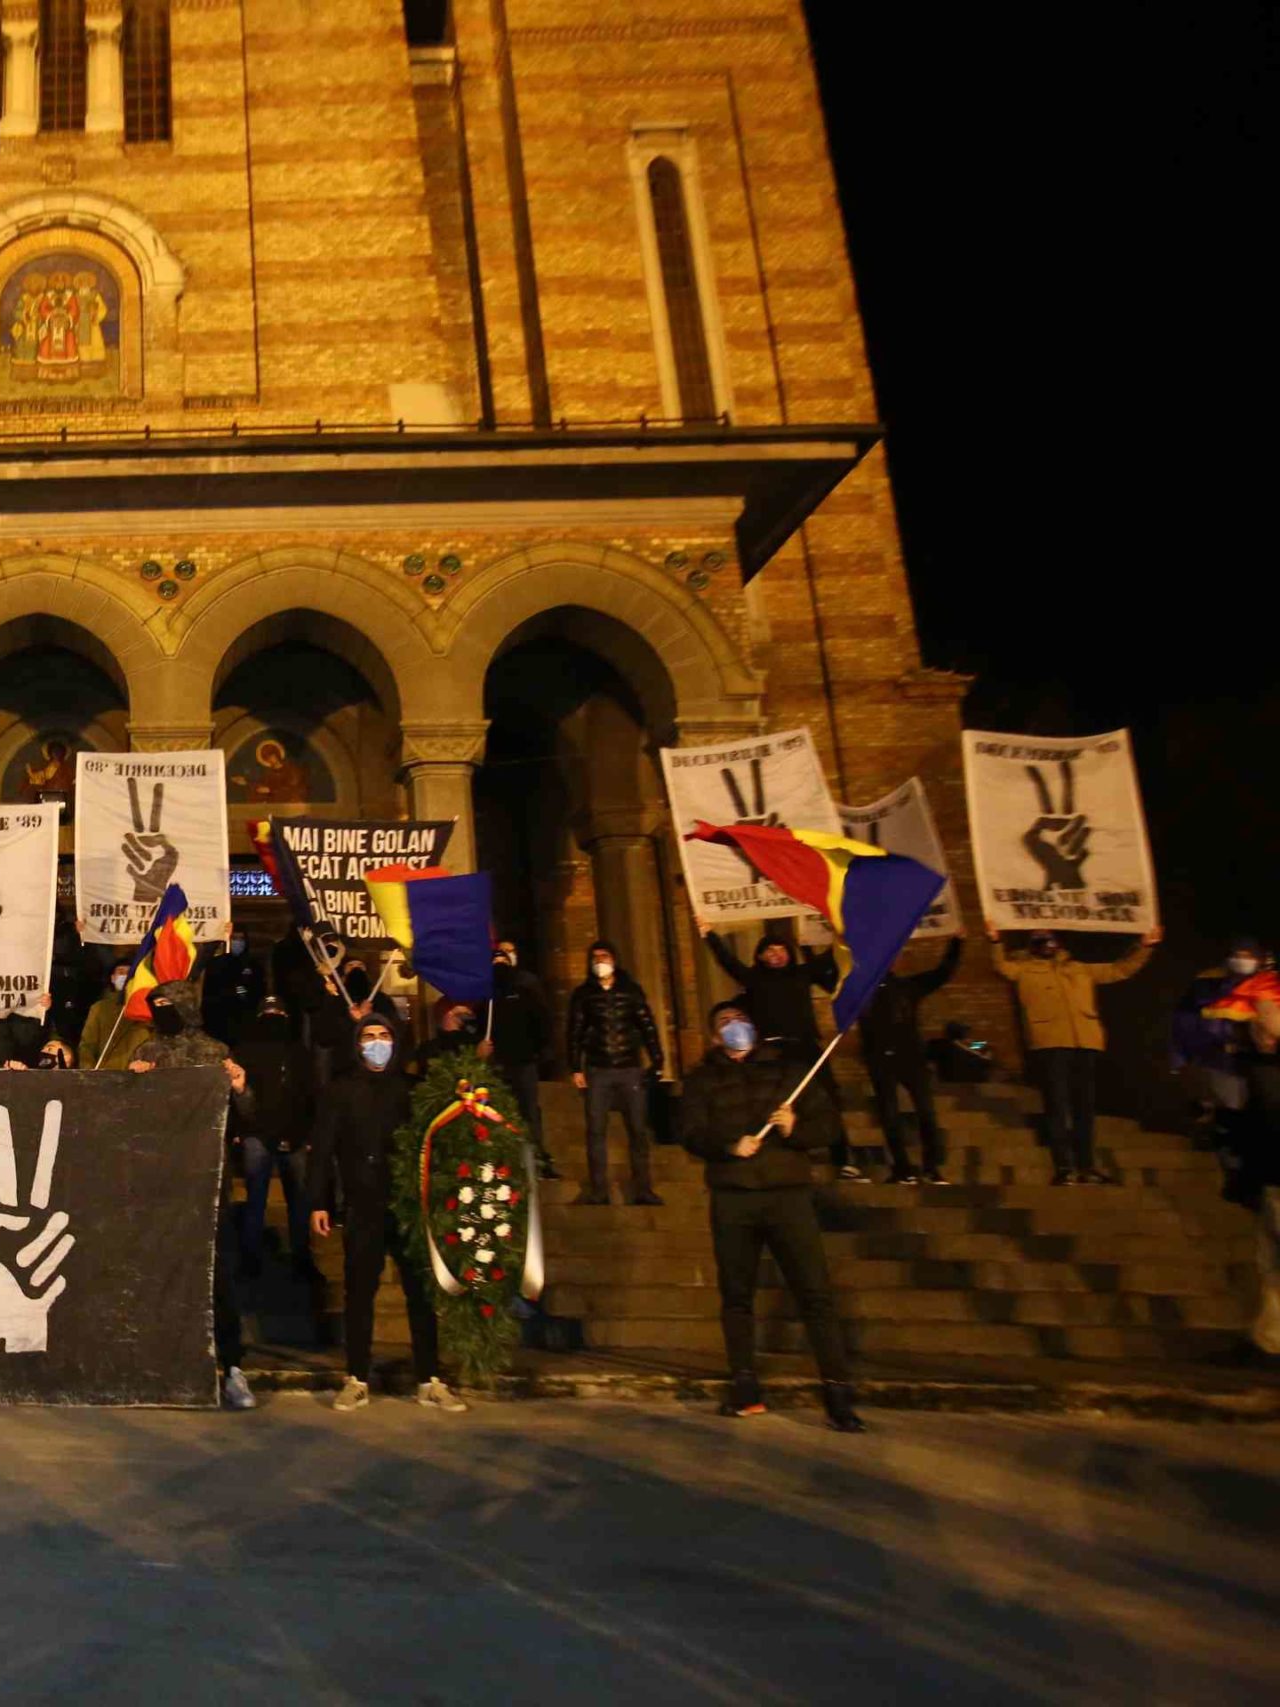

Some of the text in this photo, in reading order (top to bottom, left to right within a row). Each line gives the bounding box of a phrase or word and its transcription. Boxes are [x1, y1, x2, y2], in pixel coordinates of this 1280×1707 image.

[16, 814, 42, 829] '89
[283, 825, 436, 854] MAI BINE GOLAN
[324, 889, 367, 914] BINE
